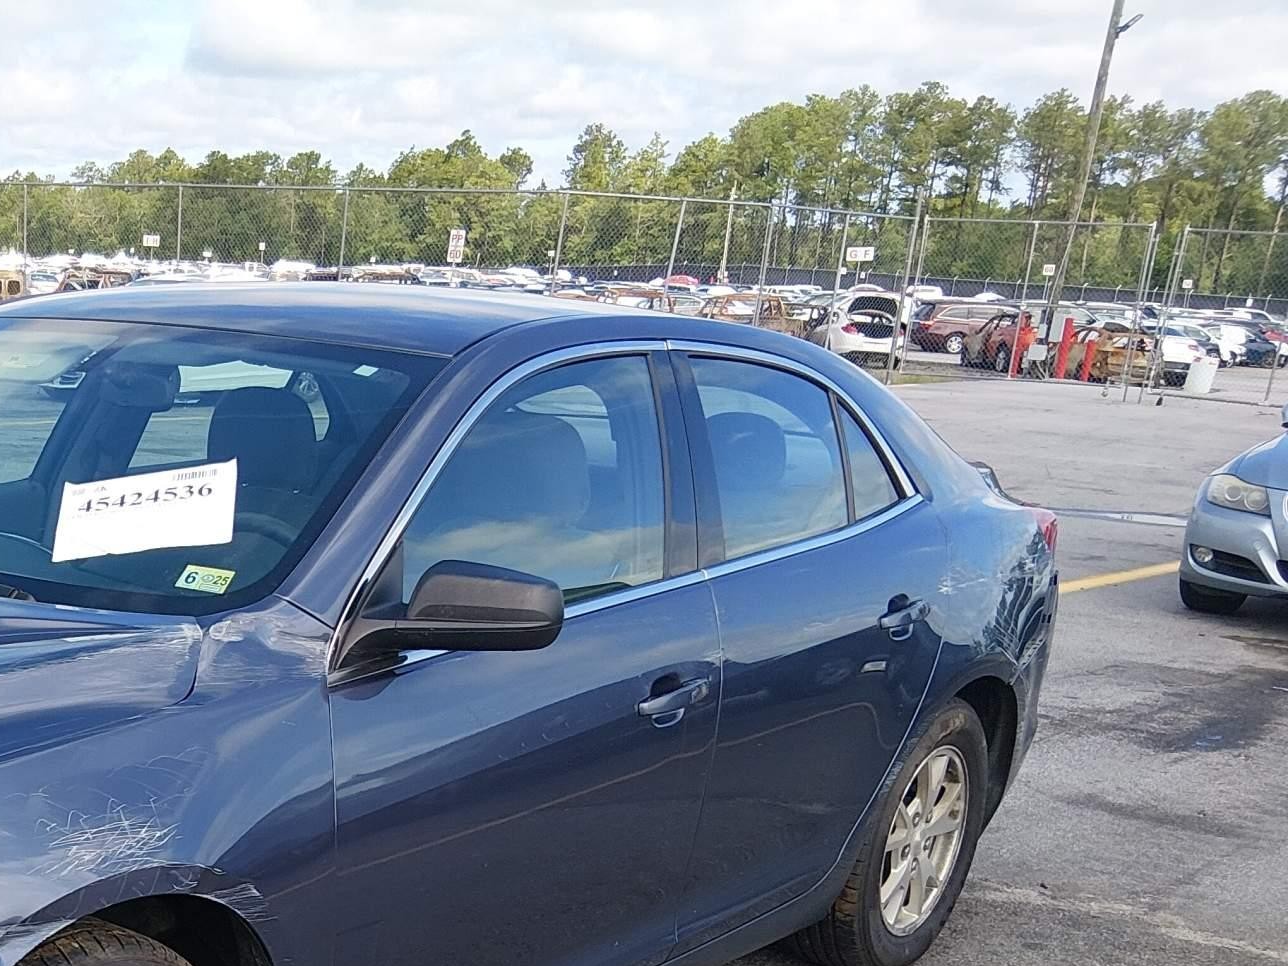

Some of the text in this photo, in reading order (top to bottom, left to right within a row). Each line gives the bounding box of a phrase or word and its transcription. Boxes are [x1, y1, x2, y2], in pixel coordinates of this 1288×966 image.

[850, 249, 871, 259] G F
[78, 482, 213, 512] 45424536
[184, 571, 199, 584] 6
[212, 575, 231, 586] 25
